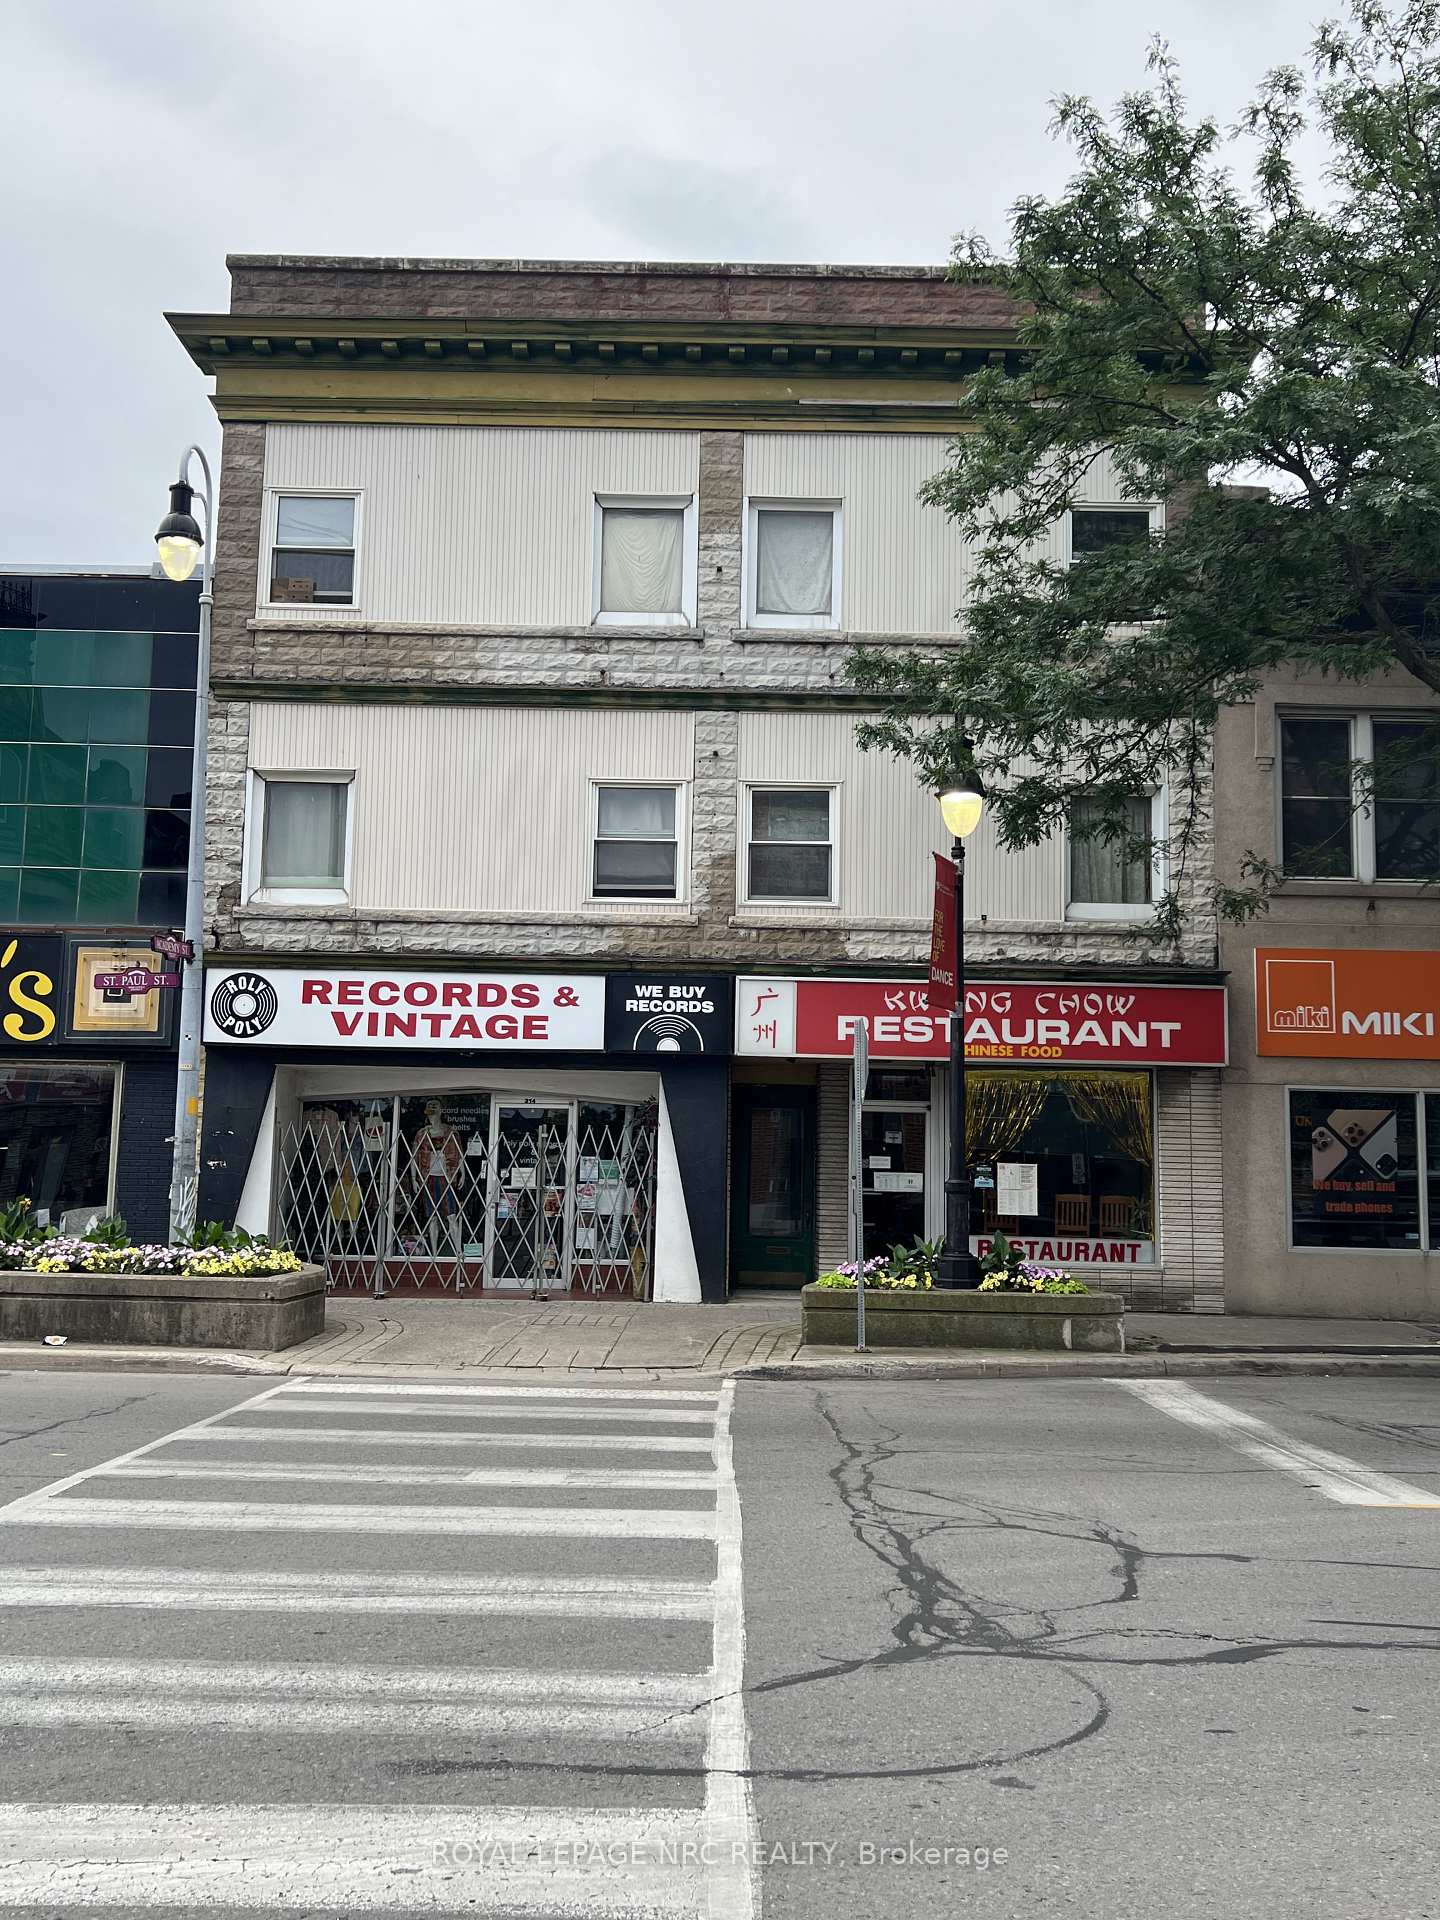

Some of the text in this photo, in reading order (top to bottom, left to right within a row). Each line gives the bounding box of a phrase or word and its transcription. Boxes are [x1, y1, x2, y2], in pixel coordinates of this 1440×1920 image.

[933, 937, 945, 952] LOVE
[932, 952, 940, 962] OF
[103, 975, 169, 986] ST. PAUL ST.
[225, 976, 267, 994] ROLY
[931, 966, 954, 986] DANCE
[302, 980, 580, 1008] RECORDS &
[635, 985, 706, 999] WE BUY
[625, 1000, 714, 1014] RECORDS
[883, 989, 1136, 1016] KWNG CHOW
[222, 1016, 262, 1035] POLY
[331, 1011, 549, 1040] VINTAGE
[1274, 1005, 1329, 1028] miki
[1342, 1010, 1434, 1036] MIKI
[964, 1044, 1062, 1058] HINESE FOOD
[977, 1239, 1141, 1263] RSTAURANT
